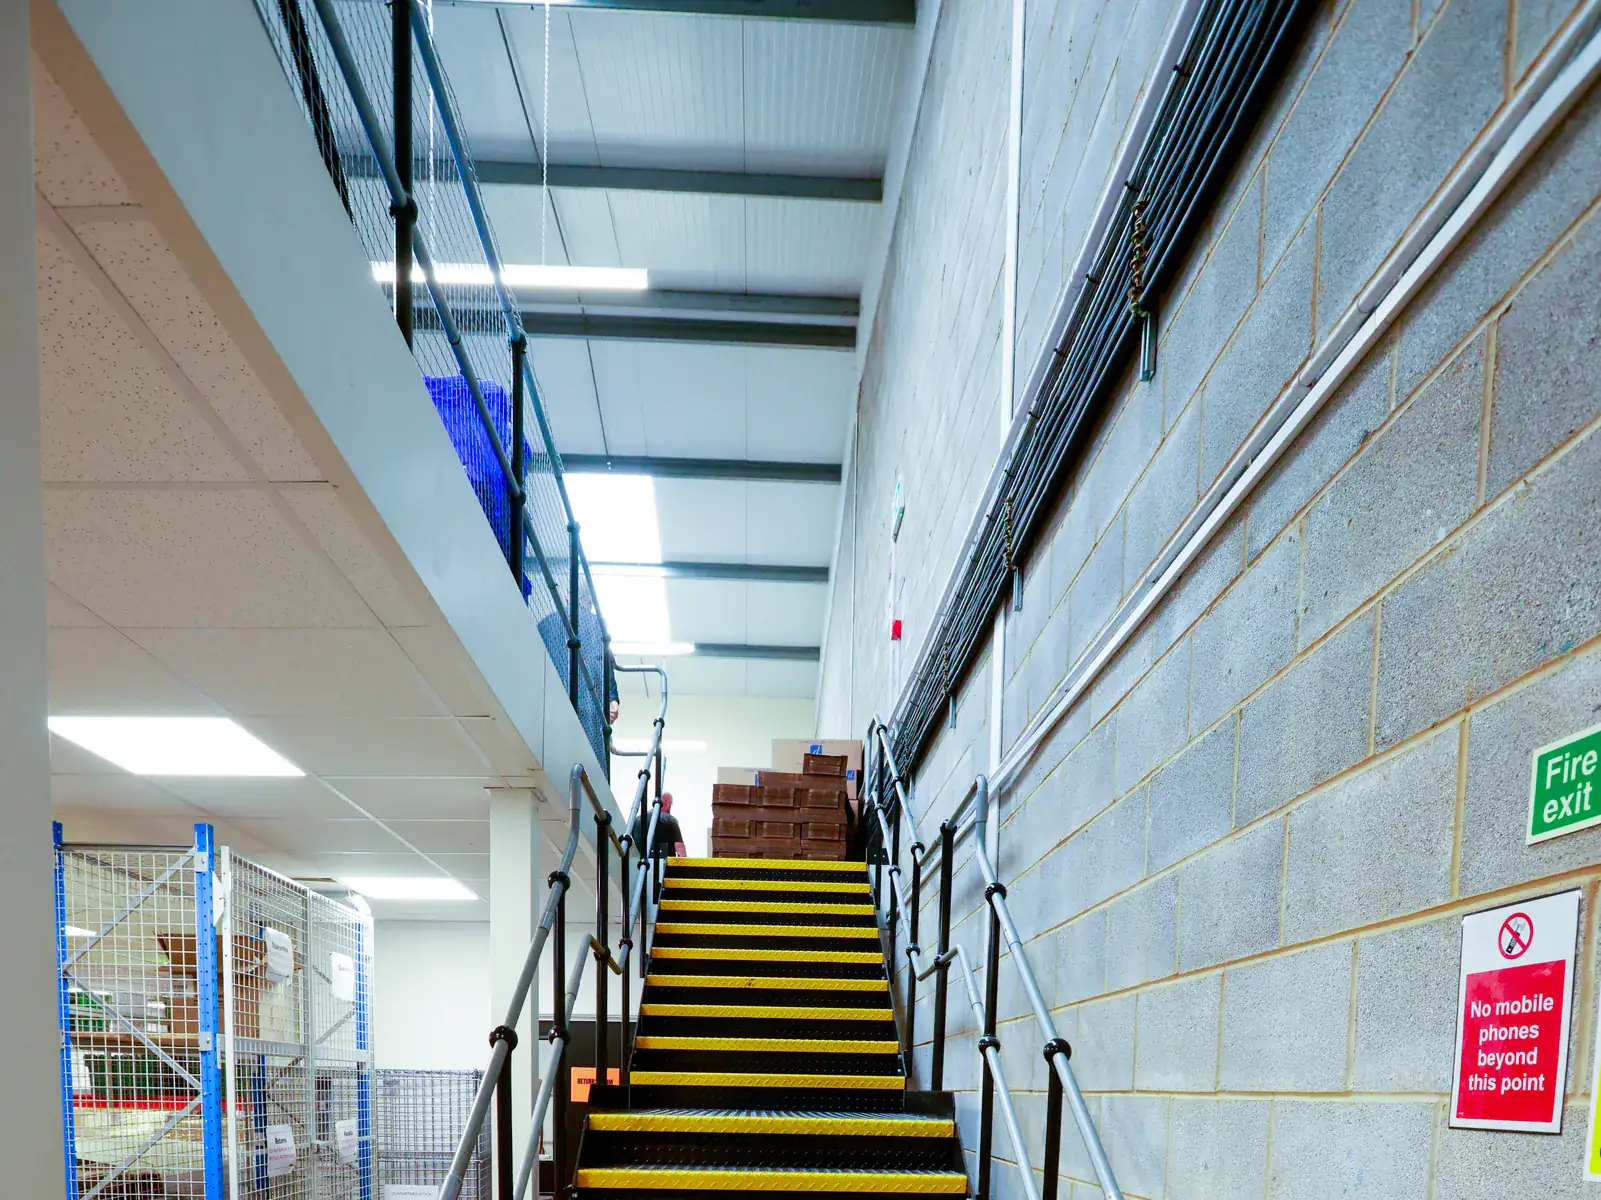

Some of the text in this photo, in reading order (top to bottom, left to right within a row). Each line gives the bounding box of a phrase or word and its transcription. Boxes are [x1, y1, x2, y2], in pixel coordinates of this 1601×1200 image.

[1545, 749, 1598, 790] Fire
[1543, 781, 1593, 824] exit
[1470, 993, 1554, 1018] No mobile
[1479, 1024, 1540, 1046] phones
[1478, 1046, 1538, 1070] beyond
[1468, 1072, 1545, 1095] this point
